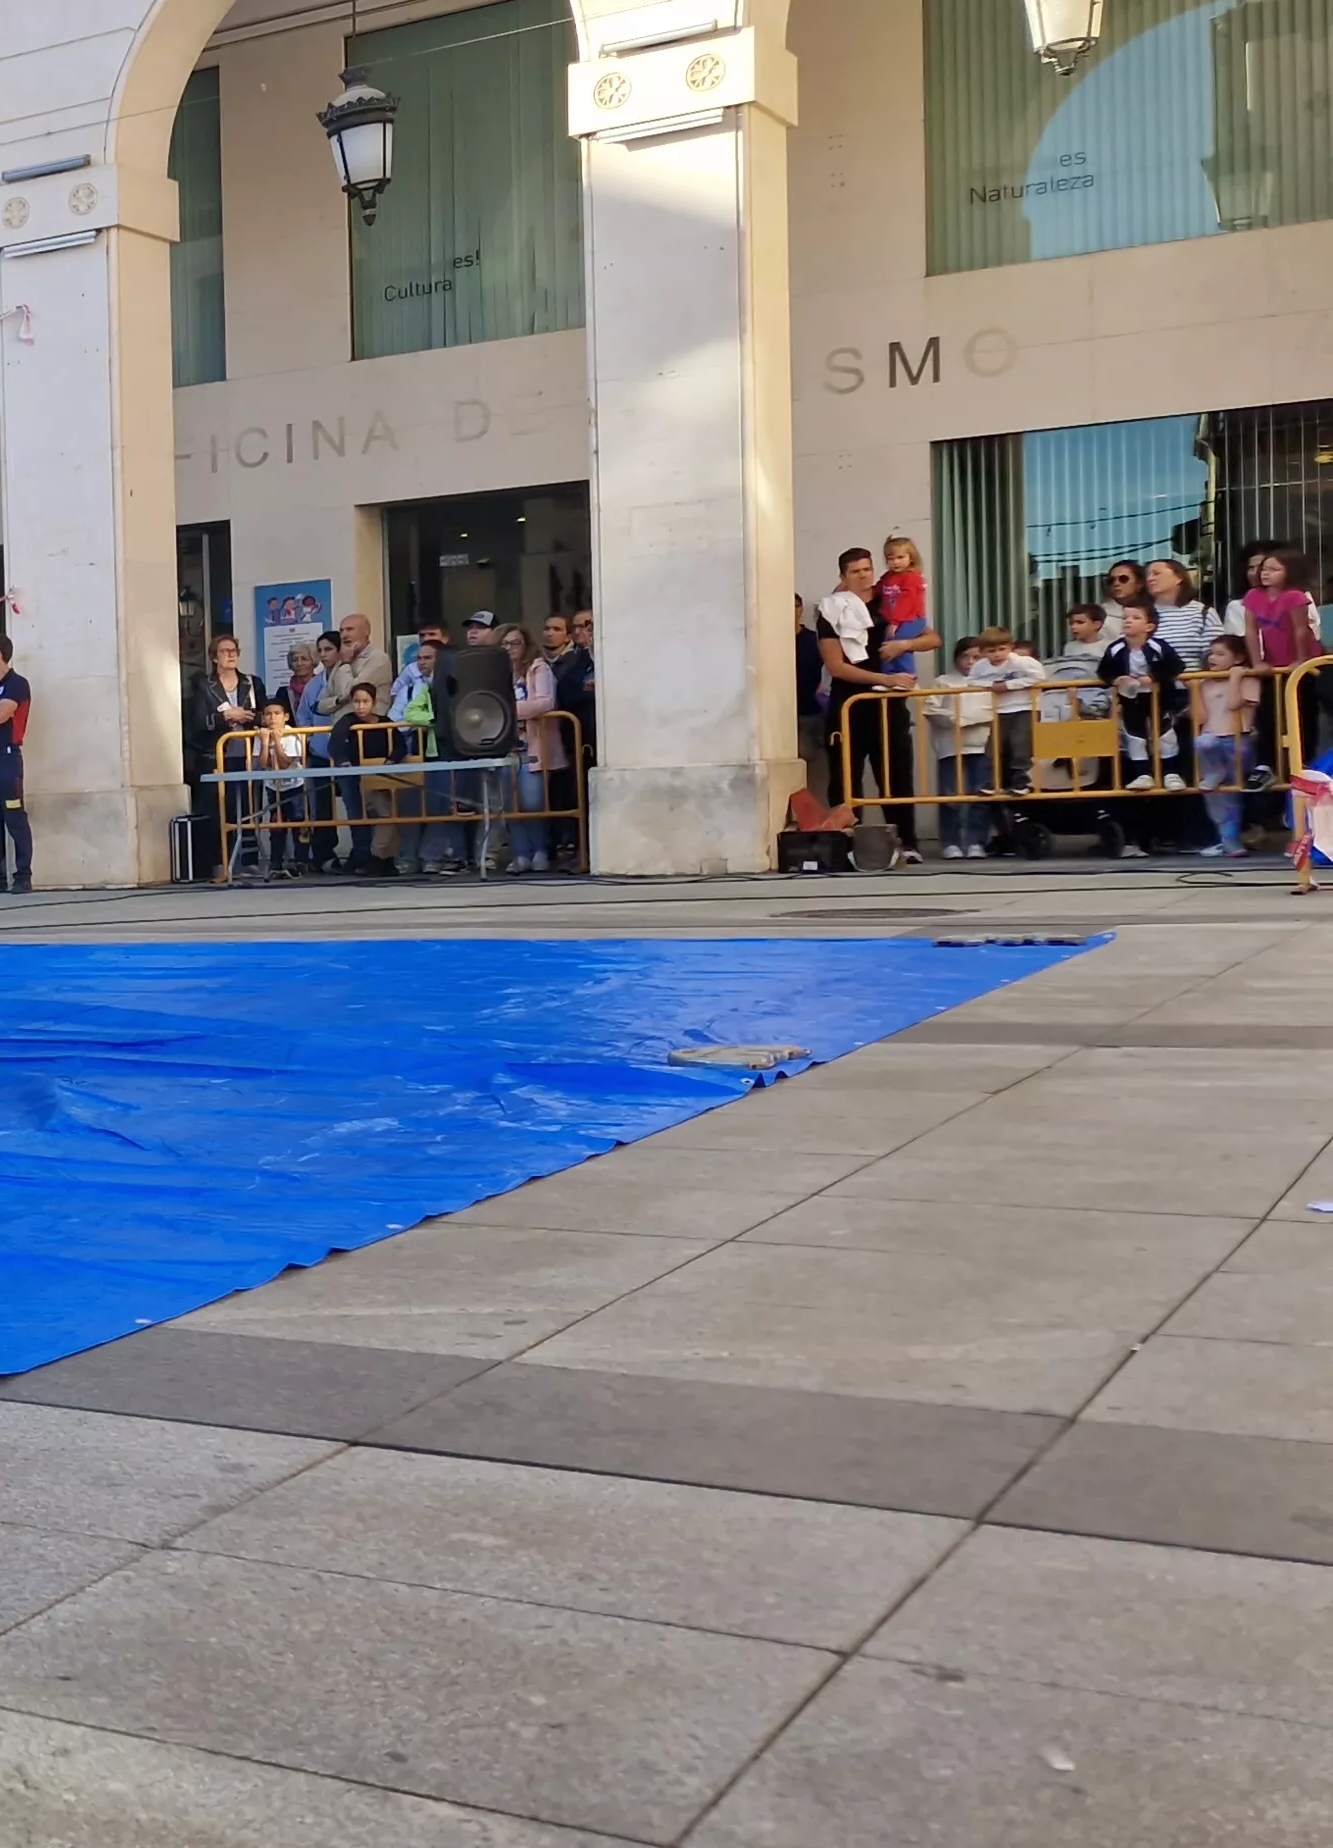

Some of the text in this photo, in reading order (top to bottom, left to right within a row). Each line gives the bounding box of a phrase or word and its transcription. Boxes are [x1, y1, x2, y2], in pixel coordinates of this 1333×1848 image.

[1059, 151, 1086, 168] es
[969, 174, 1094, 205] Naturaleza
[453, 249, 479, 269] es!
[384, 279, 452, 302] Cultura
